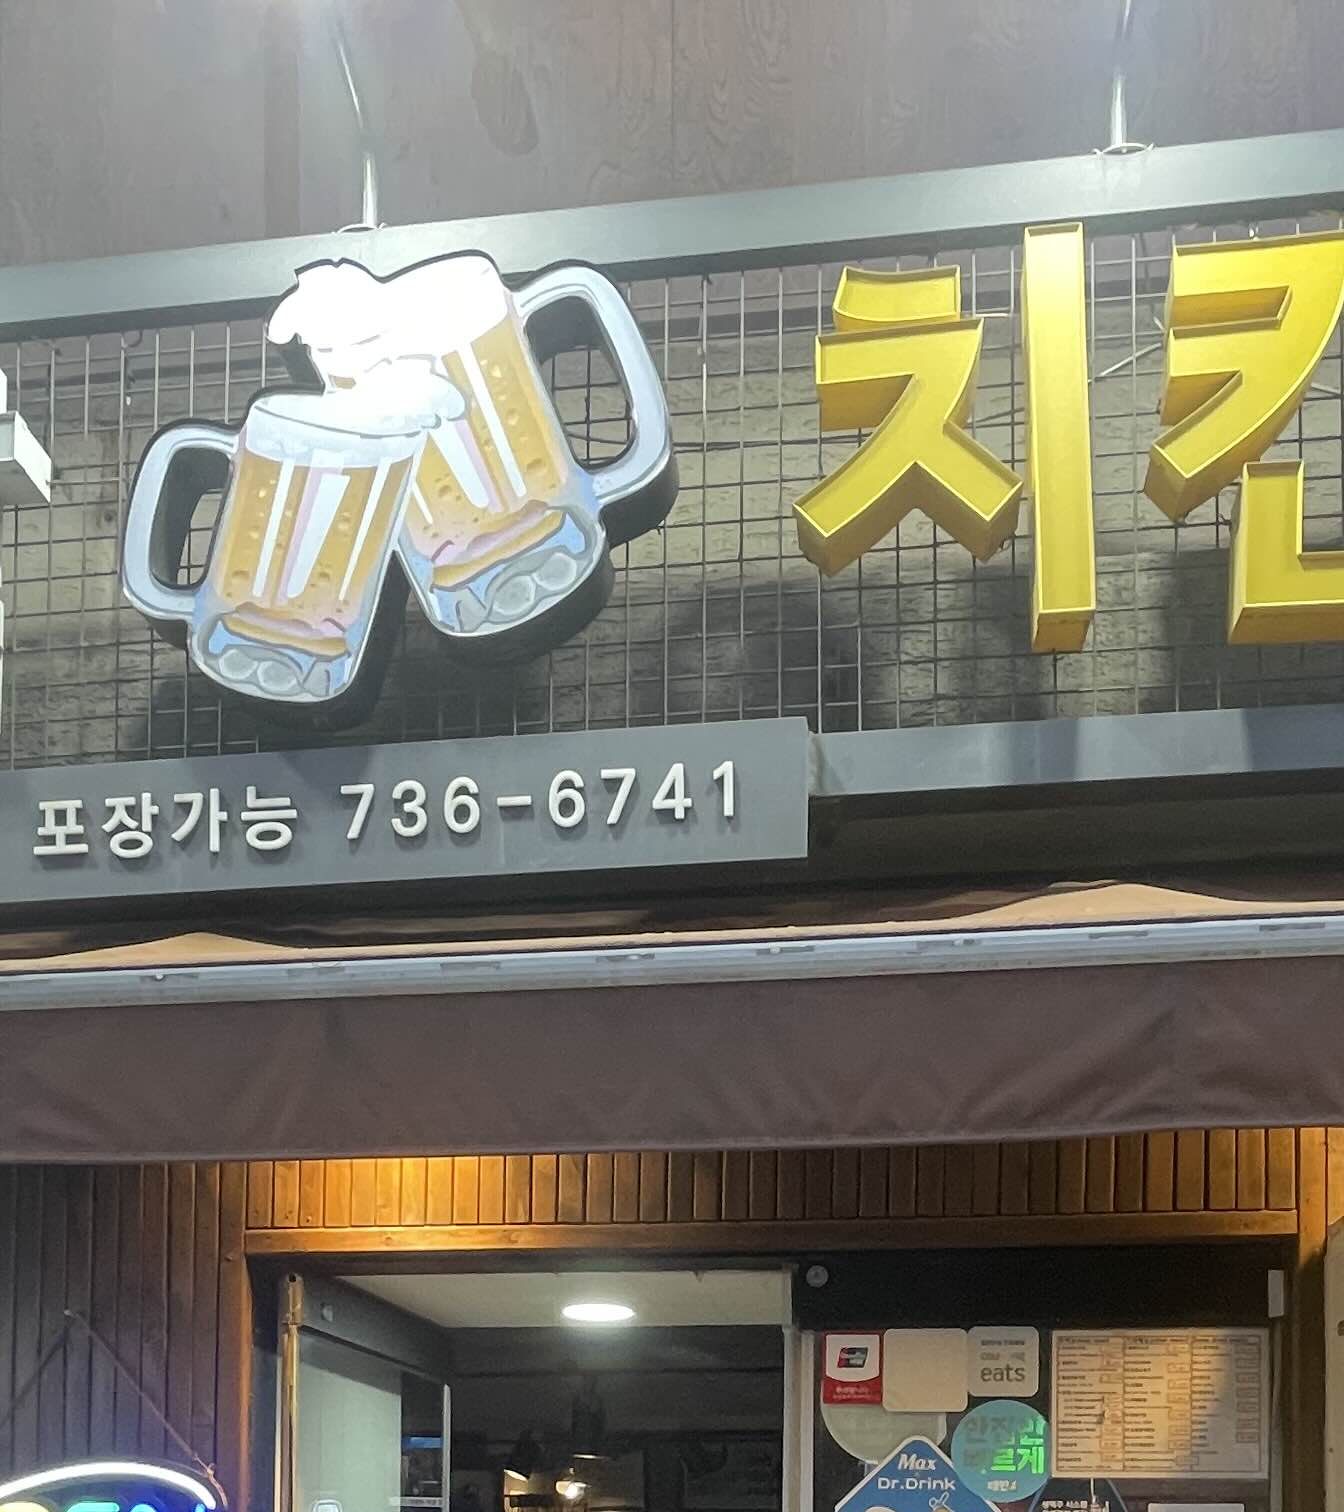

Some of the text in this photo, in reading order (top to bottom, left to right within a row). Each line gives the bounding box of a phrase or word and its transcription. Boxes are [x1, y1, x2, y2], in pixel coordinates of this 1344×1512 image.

[32, 761, 737, 860] 포장가능 736-6741
[980, 1363, 1025, 1382] eats
[897, 1454, 937, 1471] Max
[877, 1477, 956, 1490] Dr.Drink
